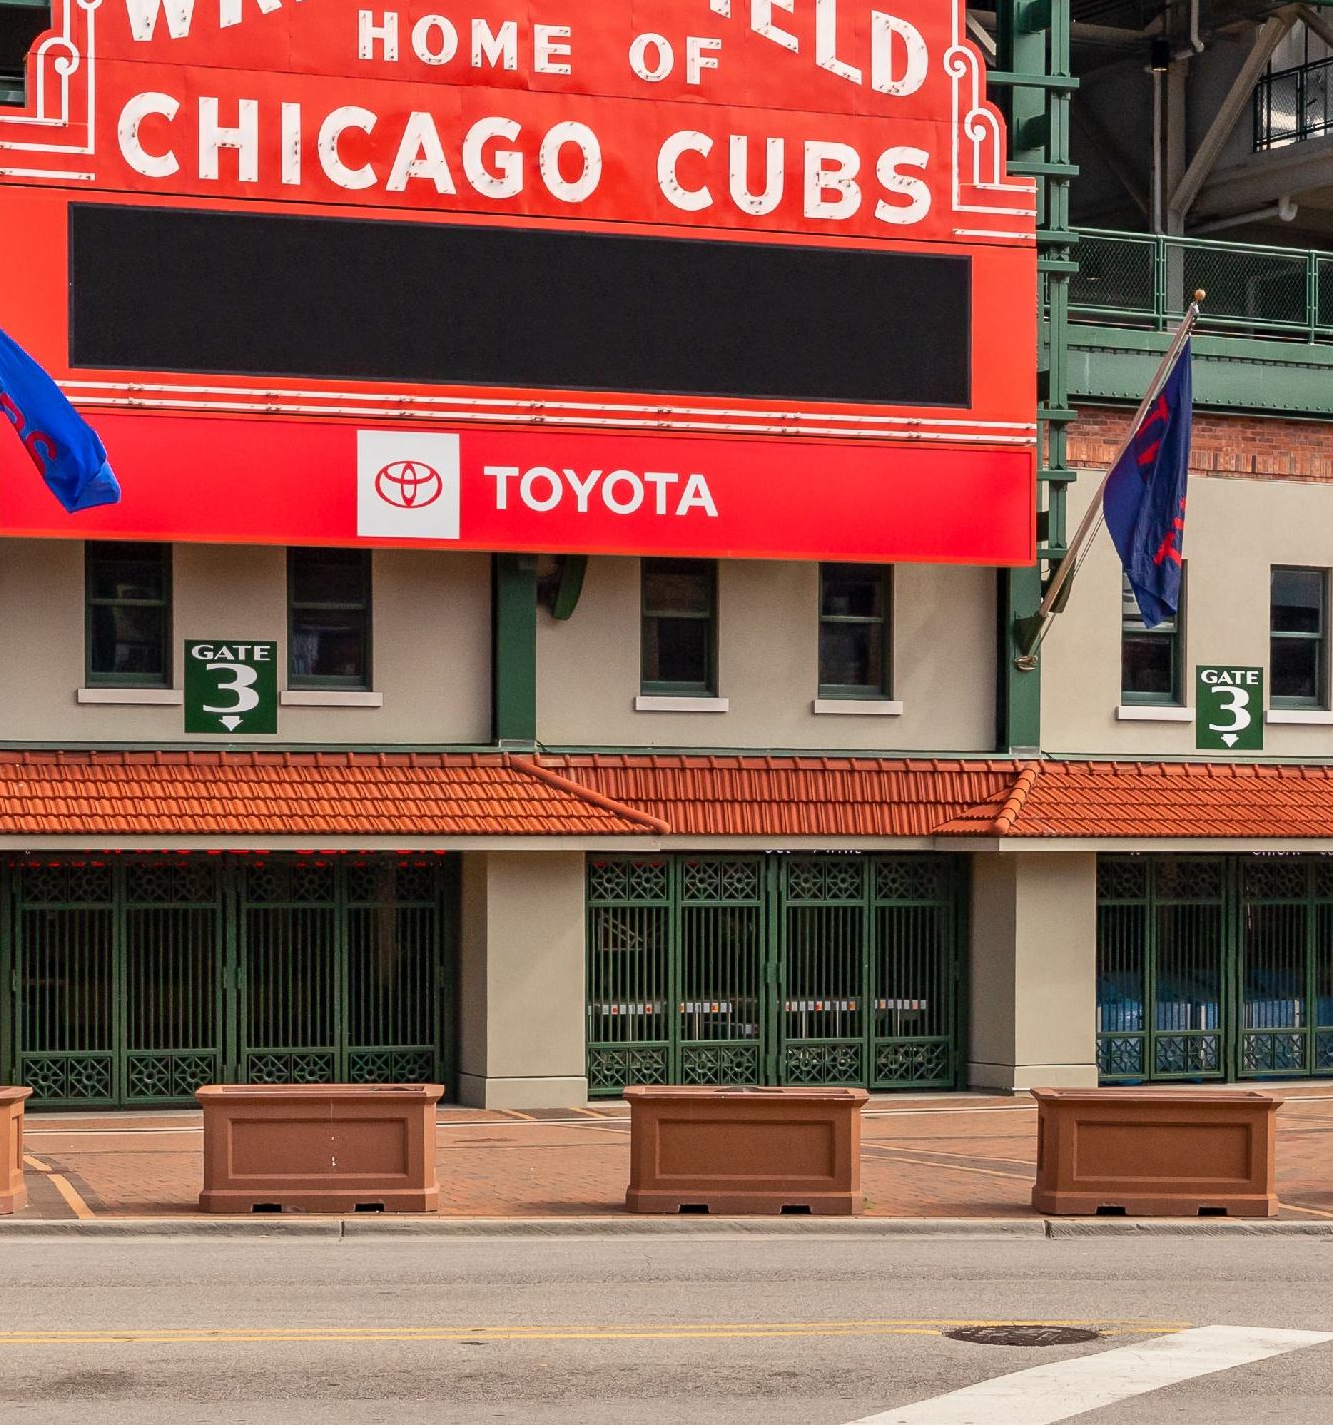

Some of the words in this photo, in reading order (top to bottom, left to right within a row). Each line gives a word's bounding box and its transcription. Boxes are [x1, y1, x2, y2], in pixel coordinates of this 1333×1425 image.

[358, 10, 573, 75] HOME
[628, 31, 722, 85] OF
[118, 91, 603, 202] CHICAGO
[656, 130, 932, 225] CUBS
[483, 464, 718, 518] TOYOTA
[191, 644, 270, 661] GATE
[1201, 669, 1260, 685] GATE
[202, 663, 260, 714] 3
[1209, 686, 1251, 733] 3
